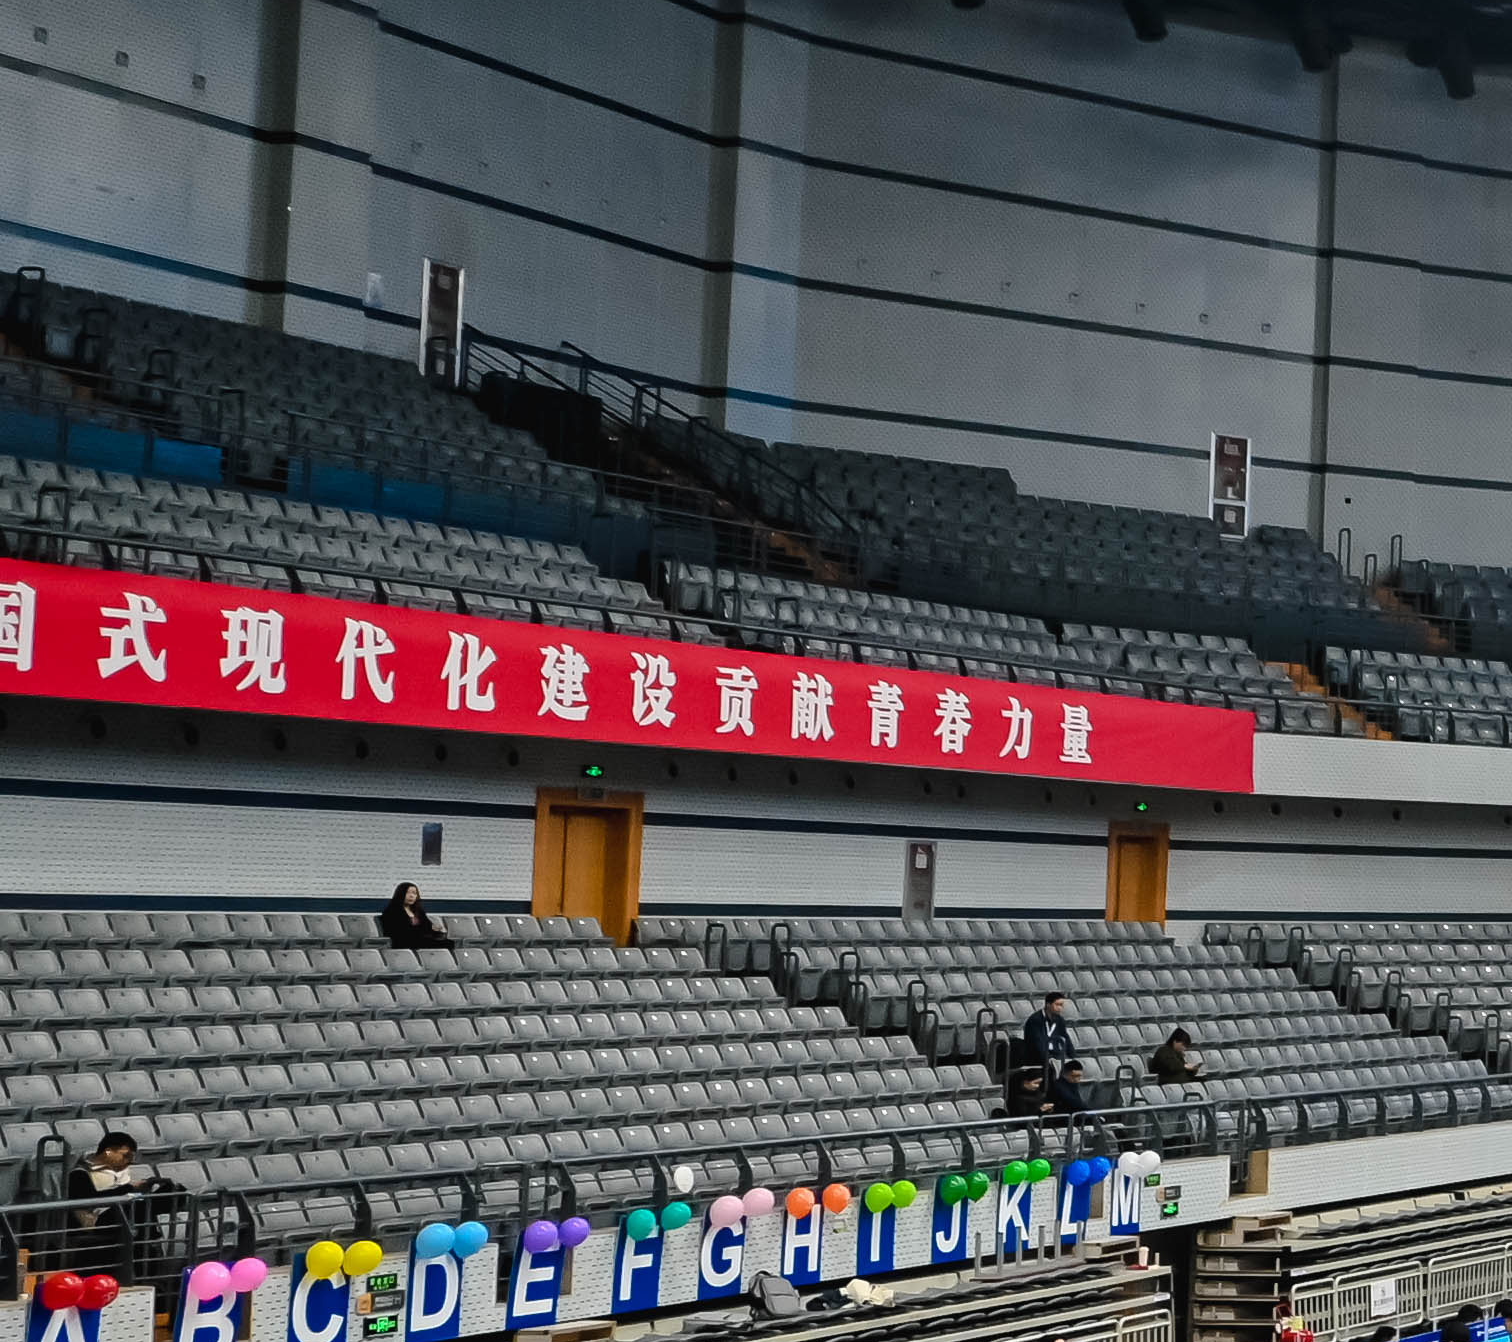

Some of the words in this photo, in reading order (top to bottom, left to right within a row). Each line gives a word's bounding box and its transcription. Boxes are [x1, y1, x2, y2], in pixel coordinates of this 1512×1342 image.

[869, 1204, 883, 1262] I
[935, 1199, 962, 1253] J
[1000, 1182, 1030, 1245] K
[1111, 1175, 1141, 1225] M
[620, 1232, 659, 1301] F
[701, 1217, 744, 1287] G
[784, 1204, 821, 1275] H
[410, 1253, 459, 1331] D
[512, 1247, 557, 1316] E
